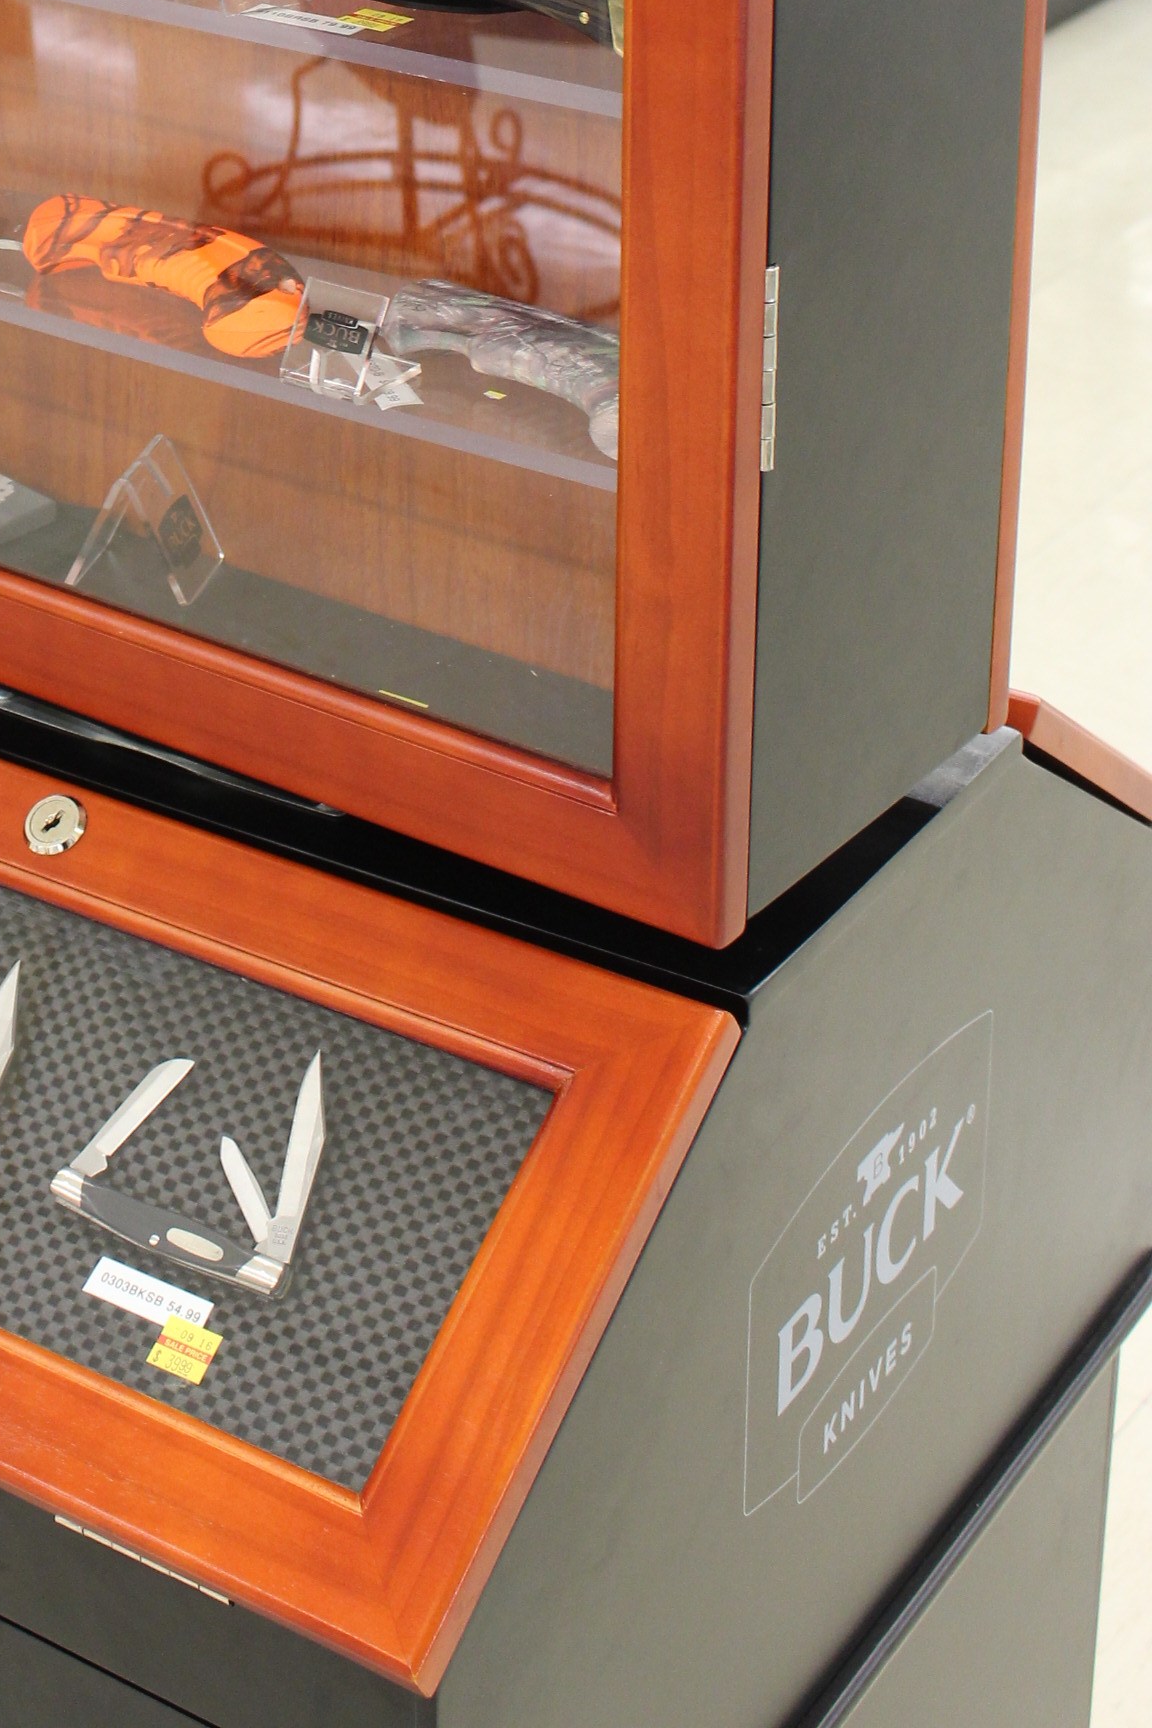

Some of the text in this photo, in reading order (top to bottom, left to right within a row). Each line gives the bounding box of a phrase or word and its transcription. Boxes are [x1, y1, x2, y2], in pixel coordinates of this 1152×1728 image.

[312, 320, 361, 345] BUCK
[816, 1106, 938, 1259] EST. 1902
[777, 1116, 965, 1416] BUCK
[100, 1272, 201, 1323] 0303BKSB 54.99
[164, 1338, 208, 1362] SALE PRICE
[179, 1329, 194, 1342] 09
[822, 1322, 913, 1453] KNIVES
